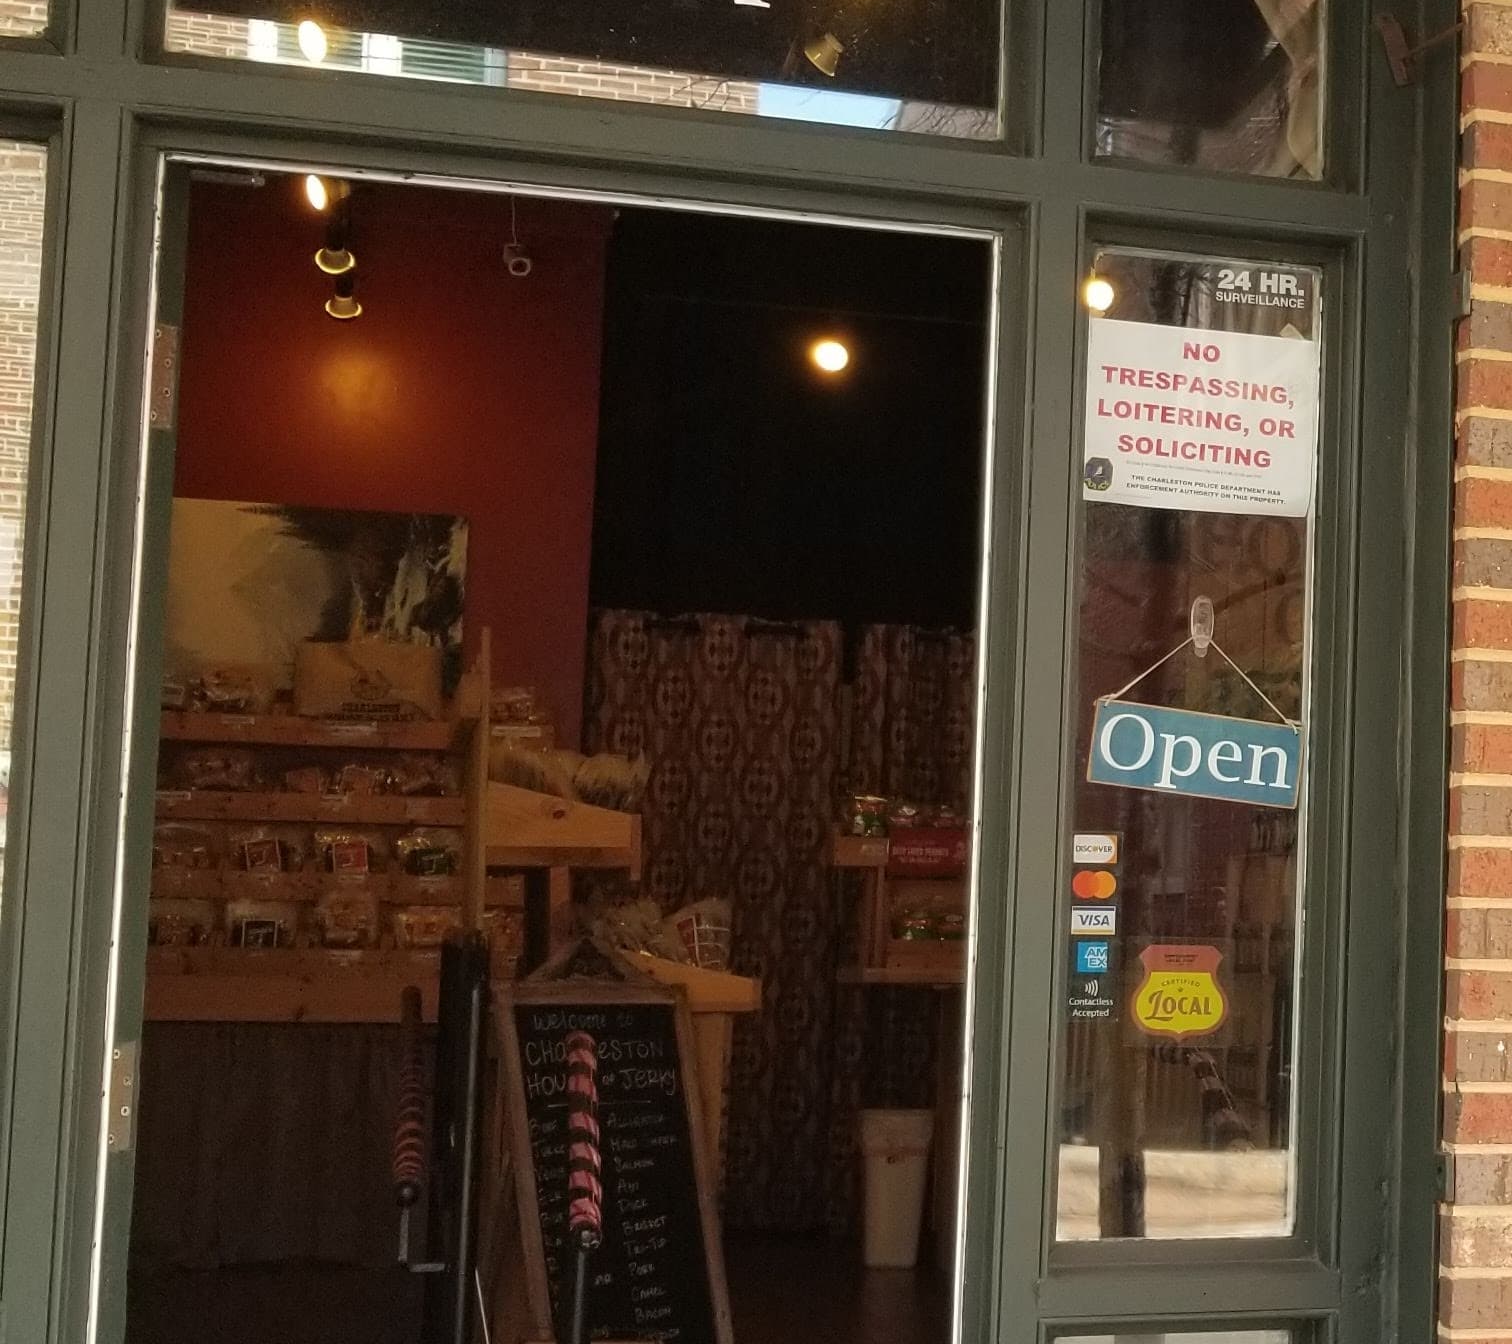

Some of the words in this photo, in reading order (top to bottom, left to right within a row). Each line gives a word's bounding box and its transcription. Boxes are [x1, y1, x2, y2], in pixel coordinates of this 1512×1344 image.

[1217, 269, 1251, 291] 24
[1259, 271, 1305, 297] HR.
[1215, 291, 1305, 309] SURVEILLANCE
[1183, 342, 1221, 362] NO
[1101, 365, 1295, 410] TRESPASSING,
[1097, 399, 1249, 437] LOITERING,
[1259, 418, 1295, 439] OR
[1117, 434, 1271, 468] SOLICITING
[1126, 482, 1177, 494] ENFORCEMENT
[1178, 487, 1219, 498] AUTHORITY
[1232, 493, 1248, 501] THIS
[1131, 474, 1145, 483] THE
[1147, 476, 1193, 487] CHARLESTON
[1194, 481, 1219, 490] POLICE
[1220, 483, 1267, 495] DEPARTMENT
[1098, 712, 1292, 791] Open
[1075, 844, 1113, 853] DISCOVER
[1078, 914, 1110, 926] VISA
[1086, 946, 1108, 958] AM
[1087, 957, 1108, 968] EX
[1160, 978, 1200, 987] CERTIFIED
[1068, 996, 1114, 1007] Contactless
[1072, 1008, 1110, 1018] Accepted
